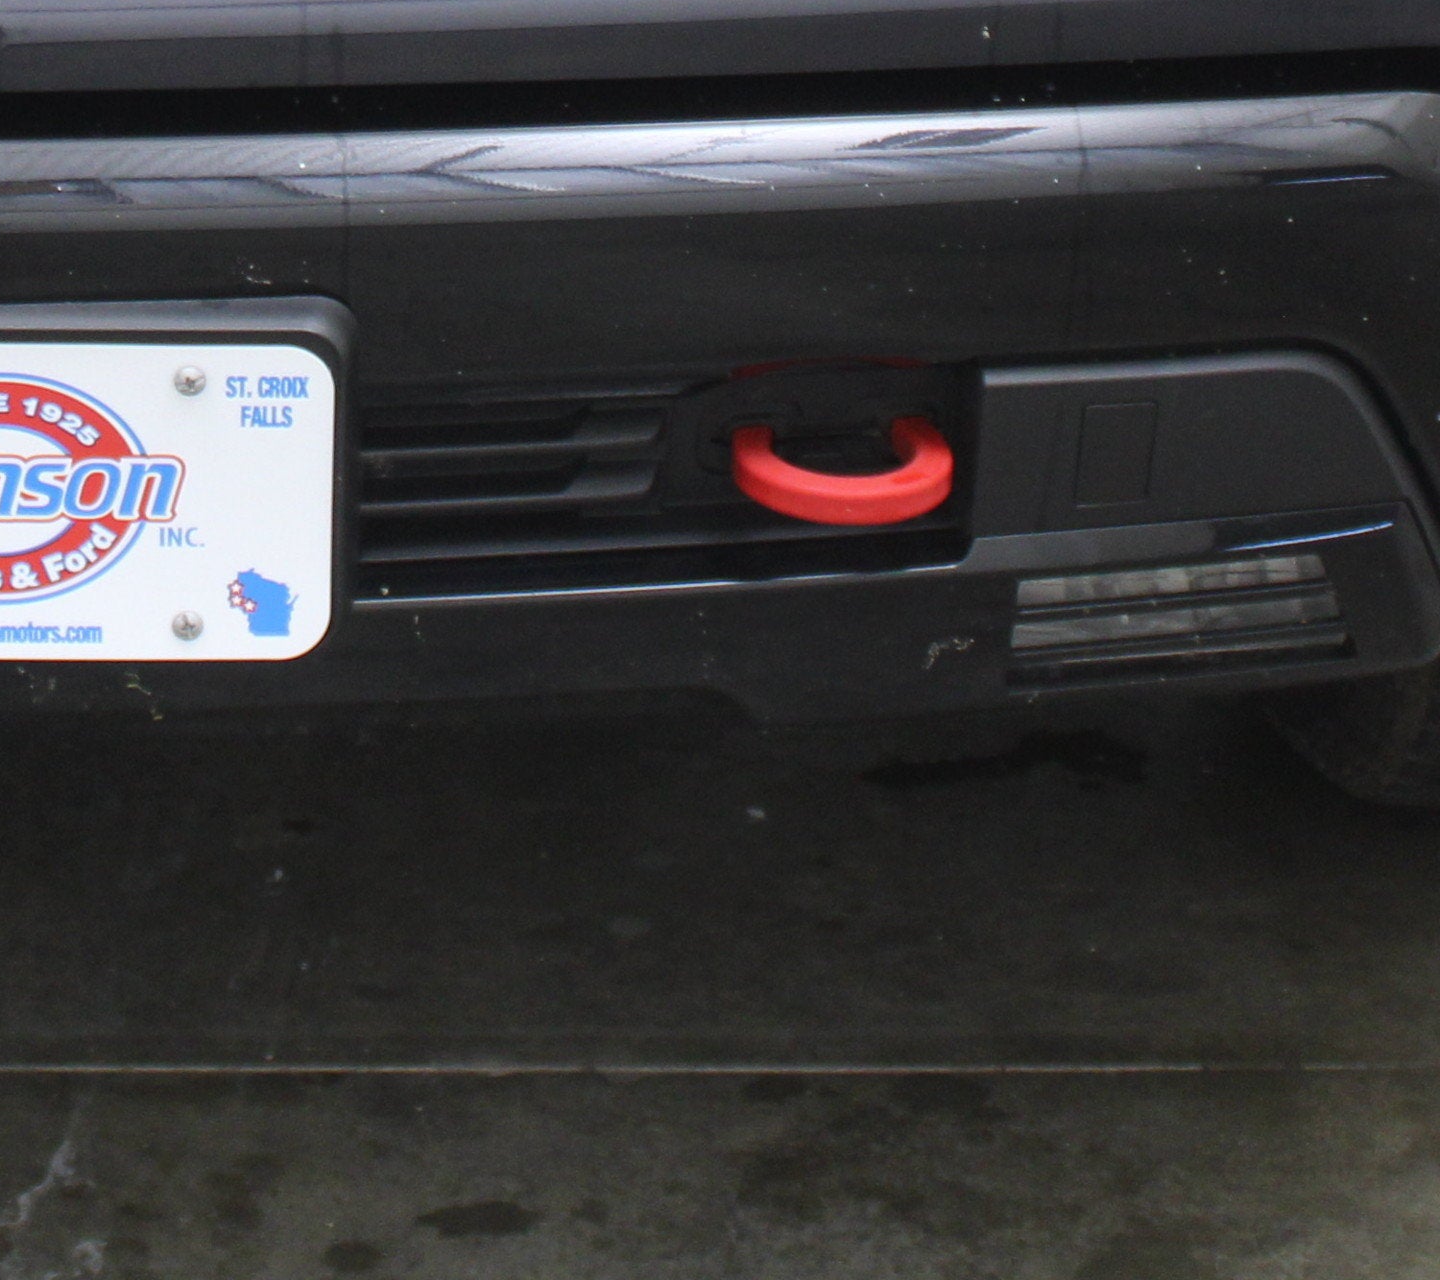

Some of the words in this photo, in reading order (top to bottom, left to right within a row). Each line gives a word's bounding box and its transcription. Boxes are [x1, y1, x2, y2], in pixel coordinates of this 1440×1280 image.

[225, 376, 252, 399] ST.
[258, 376, 310, 400] CROIX
[21, 397, 102, 446] 1925
[241, 405, 293, 429] FALLS
[159, 527, 205, 548] INC.
[10, 561, 45, 589] &
[40, 523, 118, 582] Ford
